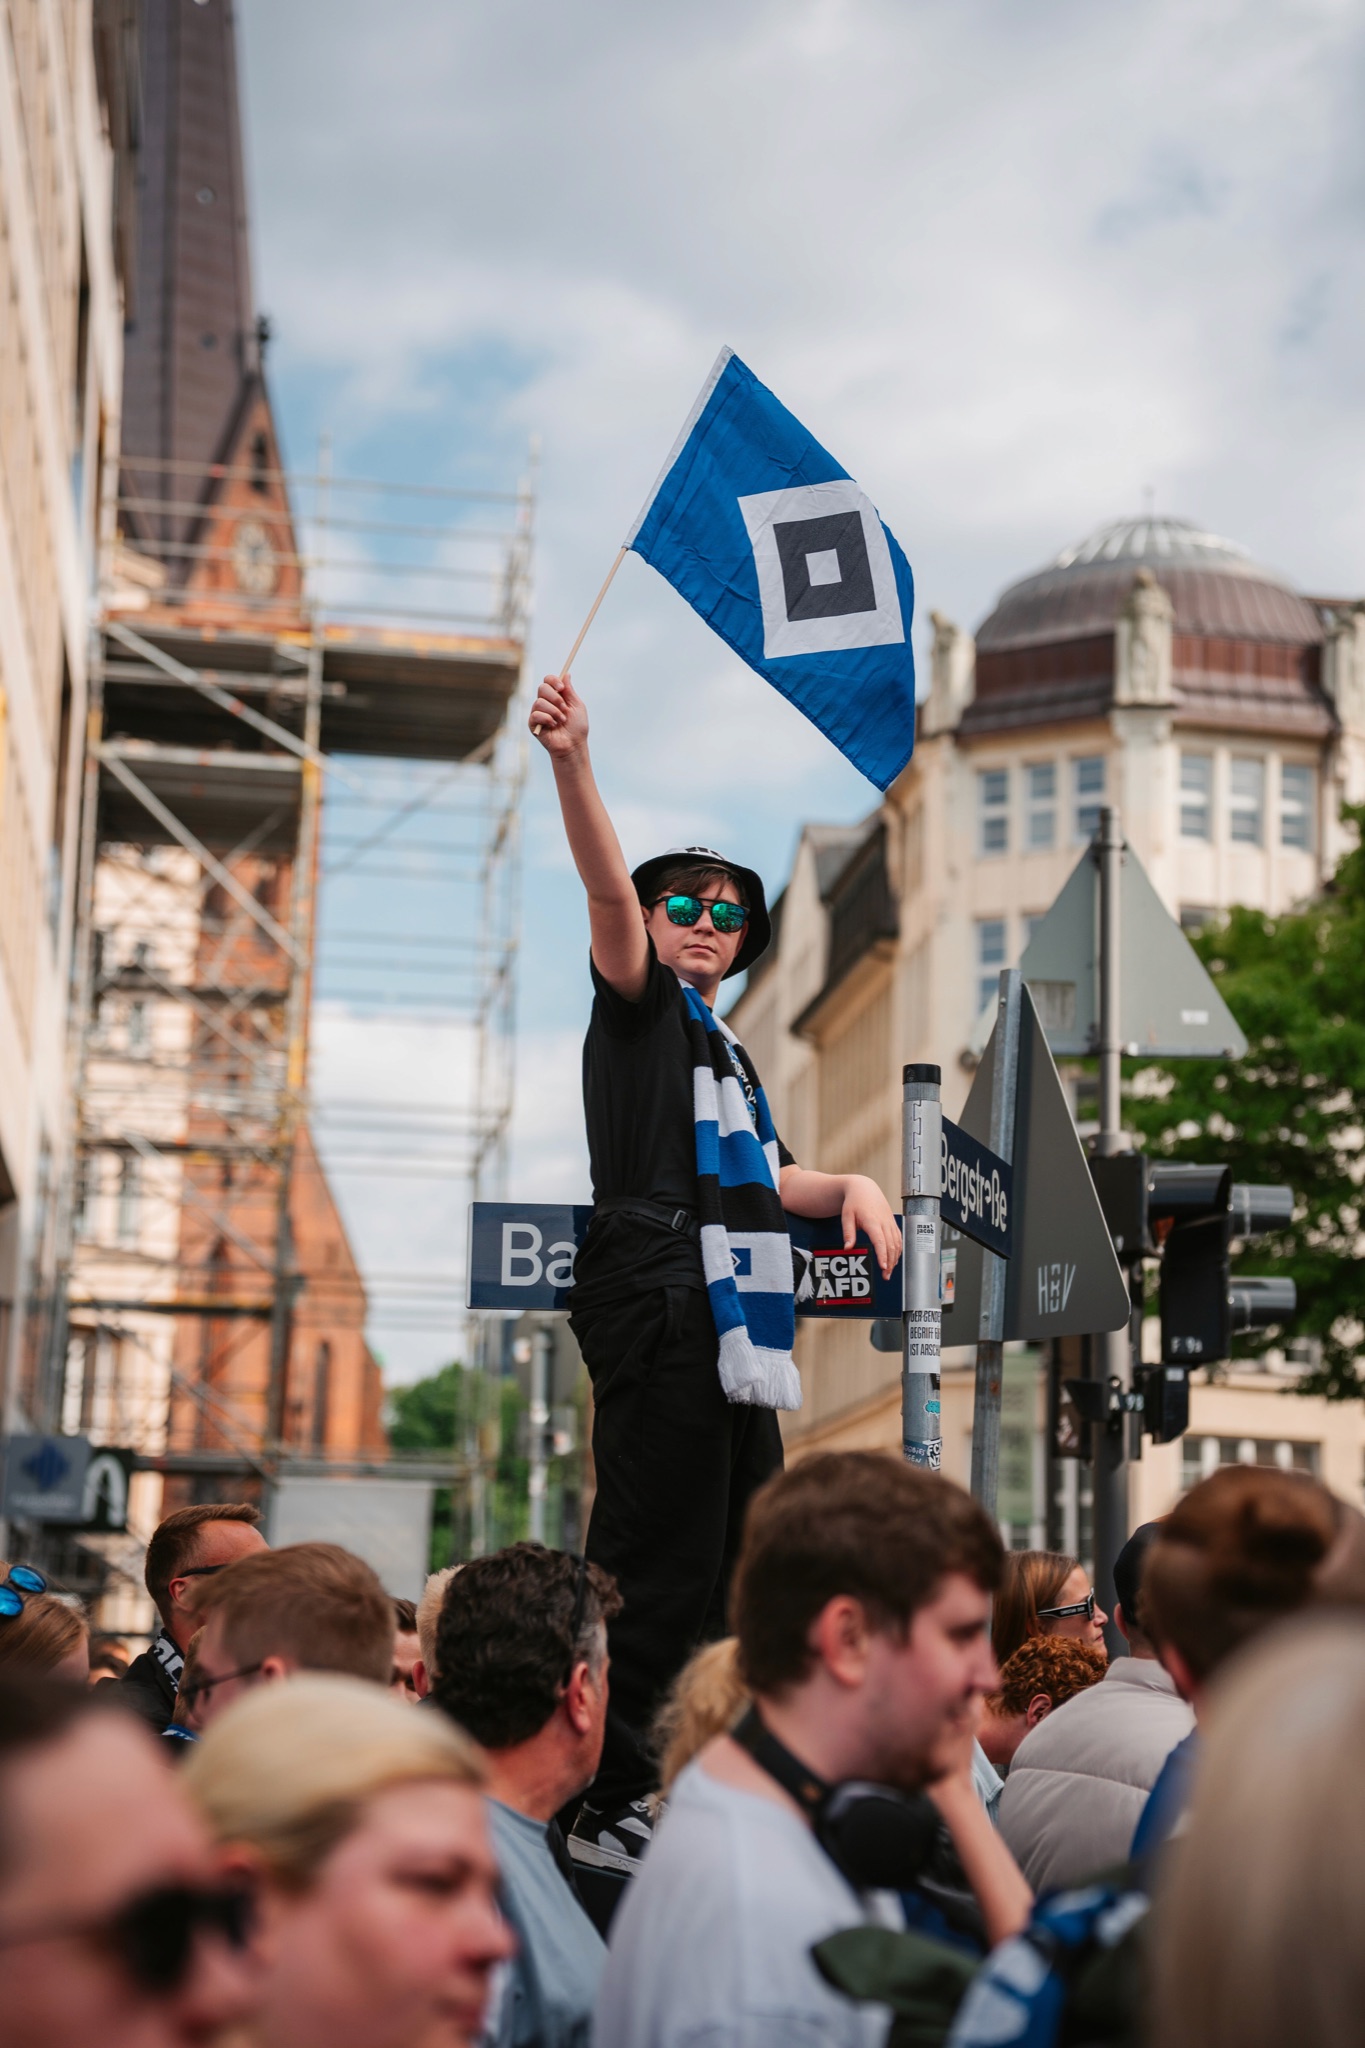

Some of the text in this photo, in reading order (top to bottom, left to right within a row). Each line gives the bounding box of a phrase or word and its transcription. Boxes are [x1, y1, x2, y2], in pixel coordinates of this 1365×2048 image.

[501, 1222, 589, 1287] Ba
[814, 1256, 869, 1278] FCK
[816, 1277, 871, 1298] AFD
[910, 1343, 919, 1356] IST
